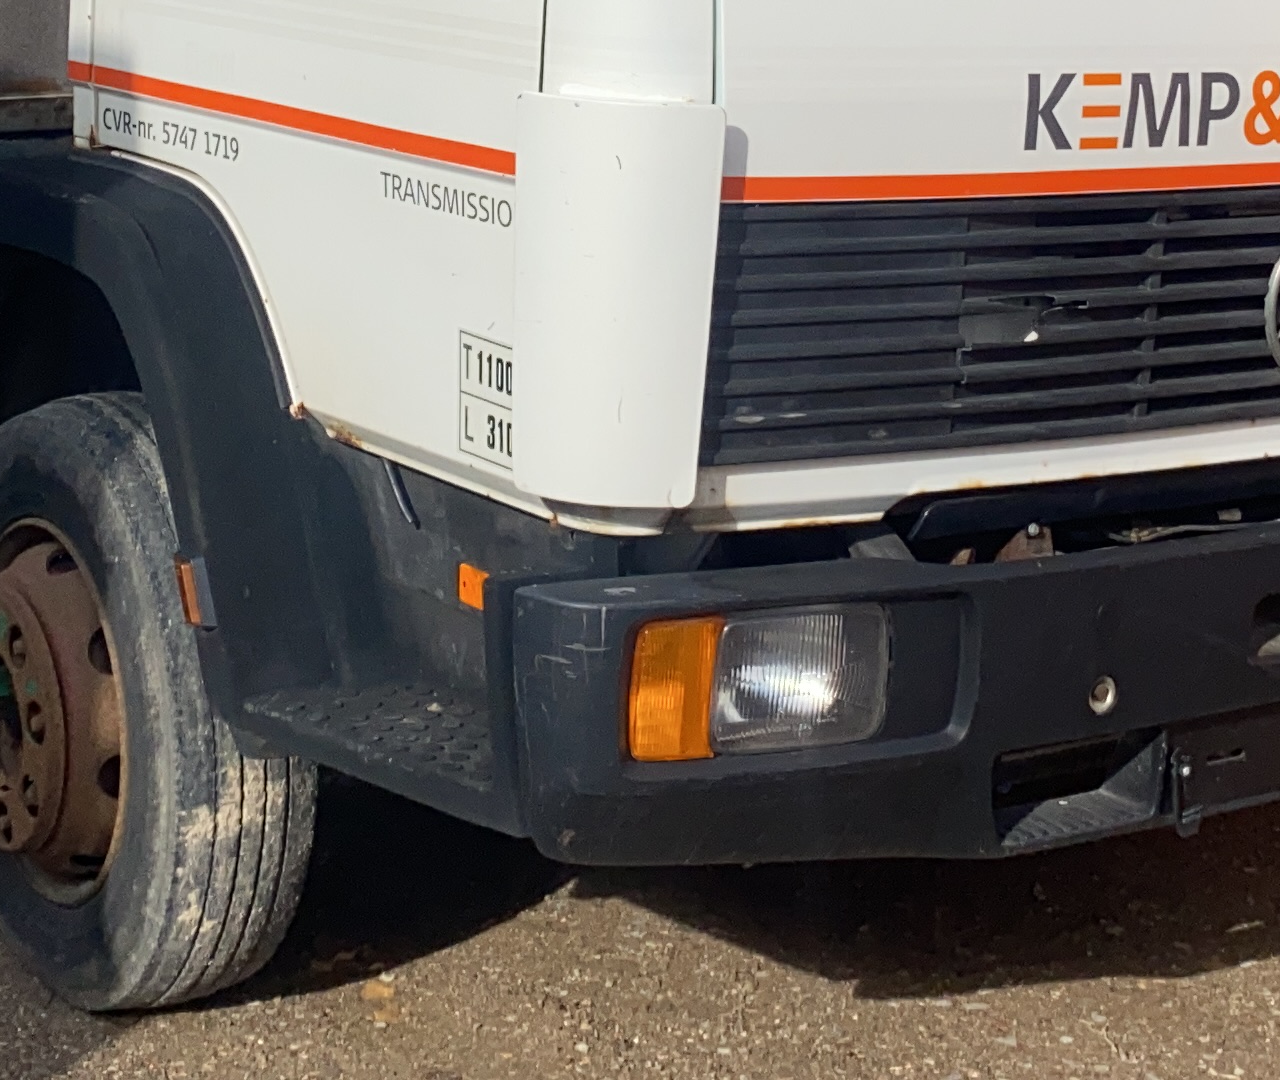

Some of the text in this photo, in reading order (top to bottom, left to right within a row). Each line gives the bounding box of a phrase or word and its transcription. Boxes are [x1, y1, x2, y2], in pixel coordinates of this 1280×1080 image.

[103, 107, 239, 162] CVR-nr. 5747 1719
